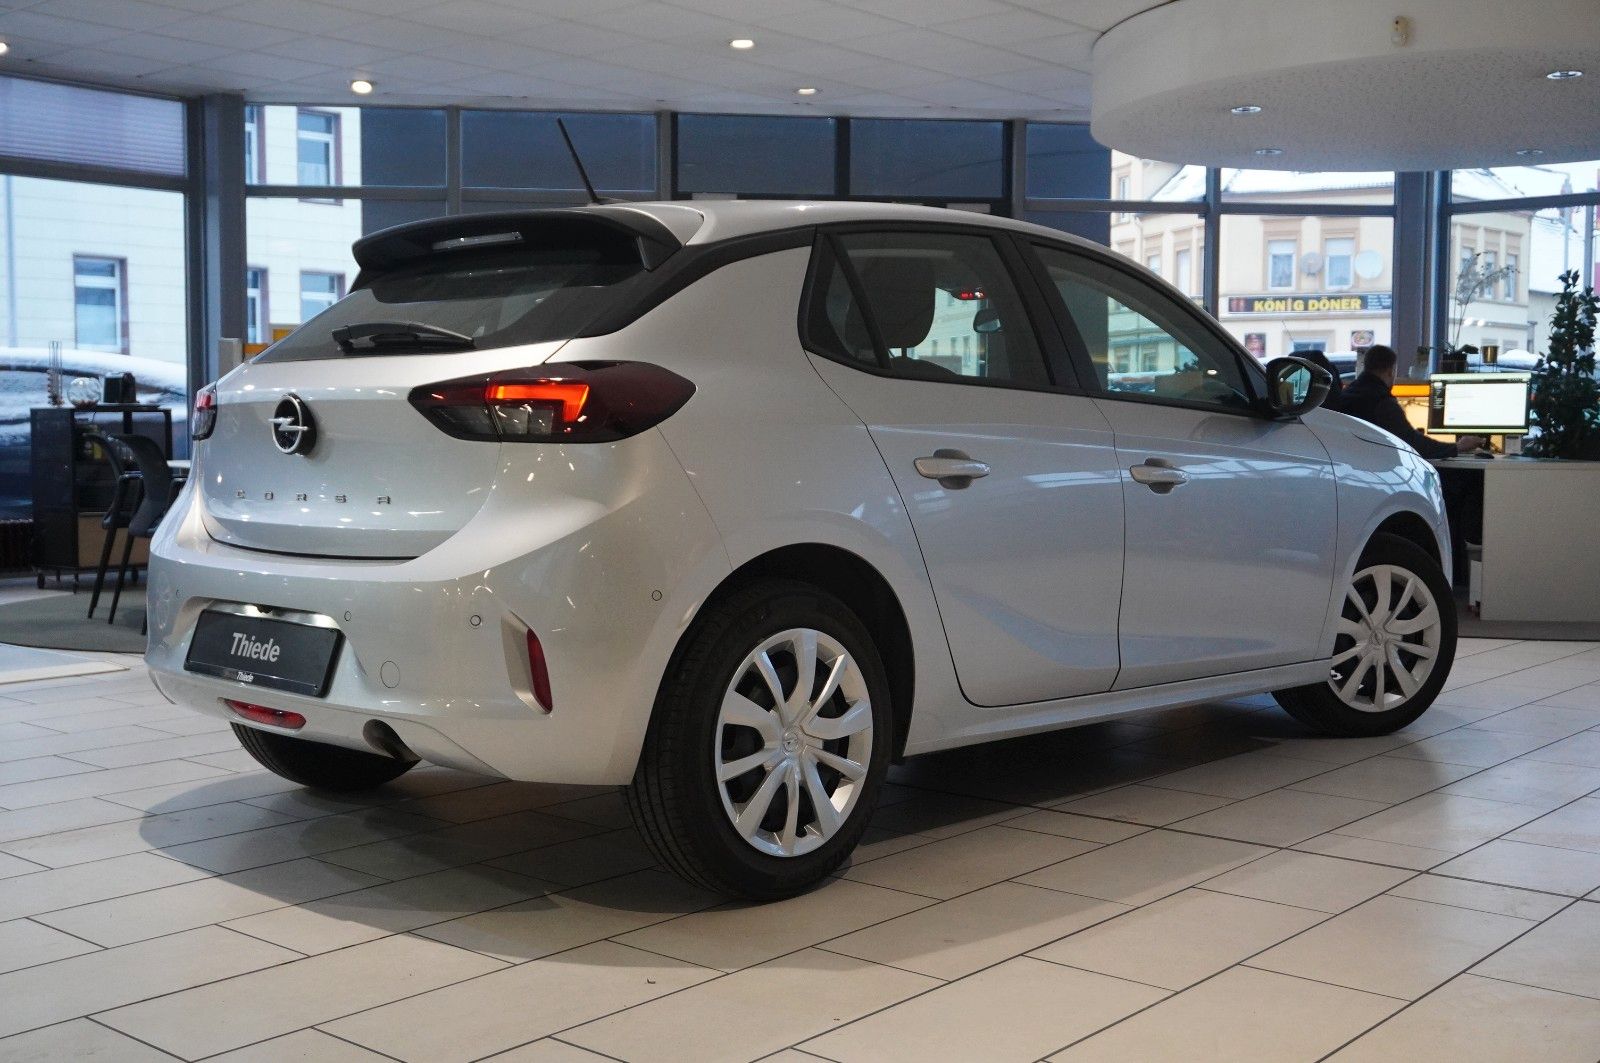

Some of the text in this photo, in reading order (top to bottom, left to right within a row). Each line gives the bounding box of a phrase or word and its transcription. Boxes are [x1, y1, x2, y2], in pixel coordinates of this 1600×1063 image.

[1308, 296, 1361, 311] DÖNER
[236, 489, 391, 504] CORSA
[230, 632, 280, 662] Thiede
[236, 671, 254, 683] Thiede
